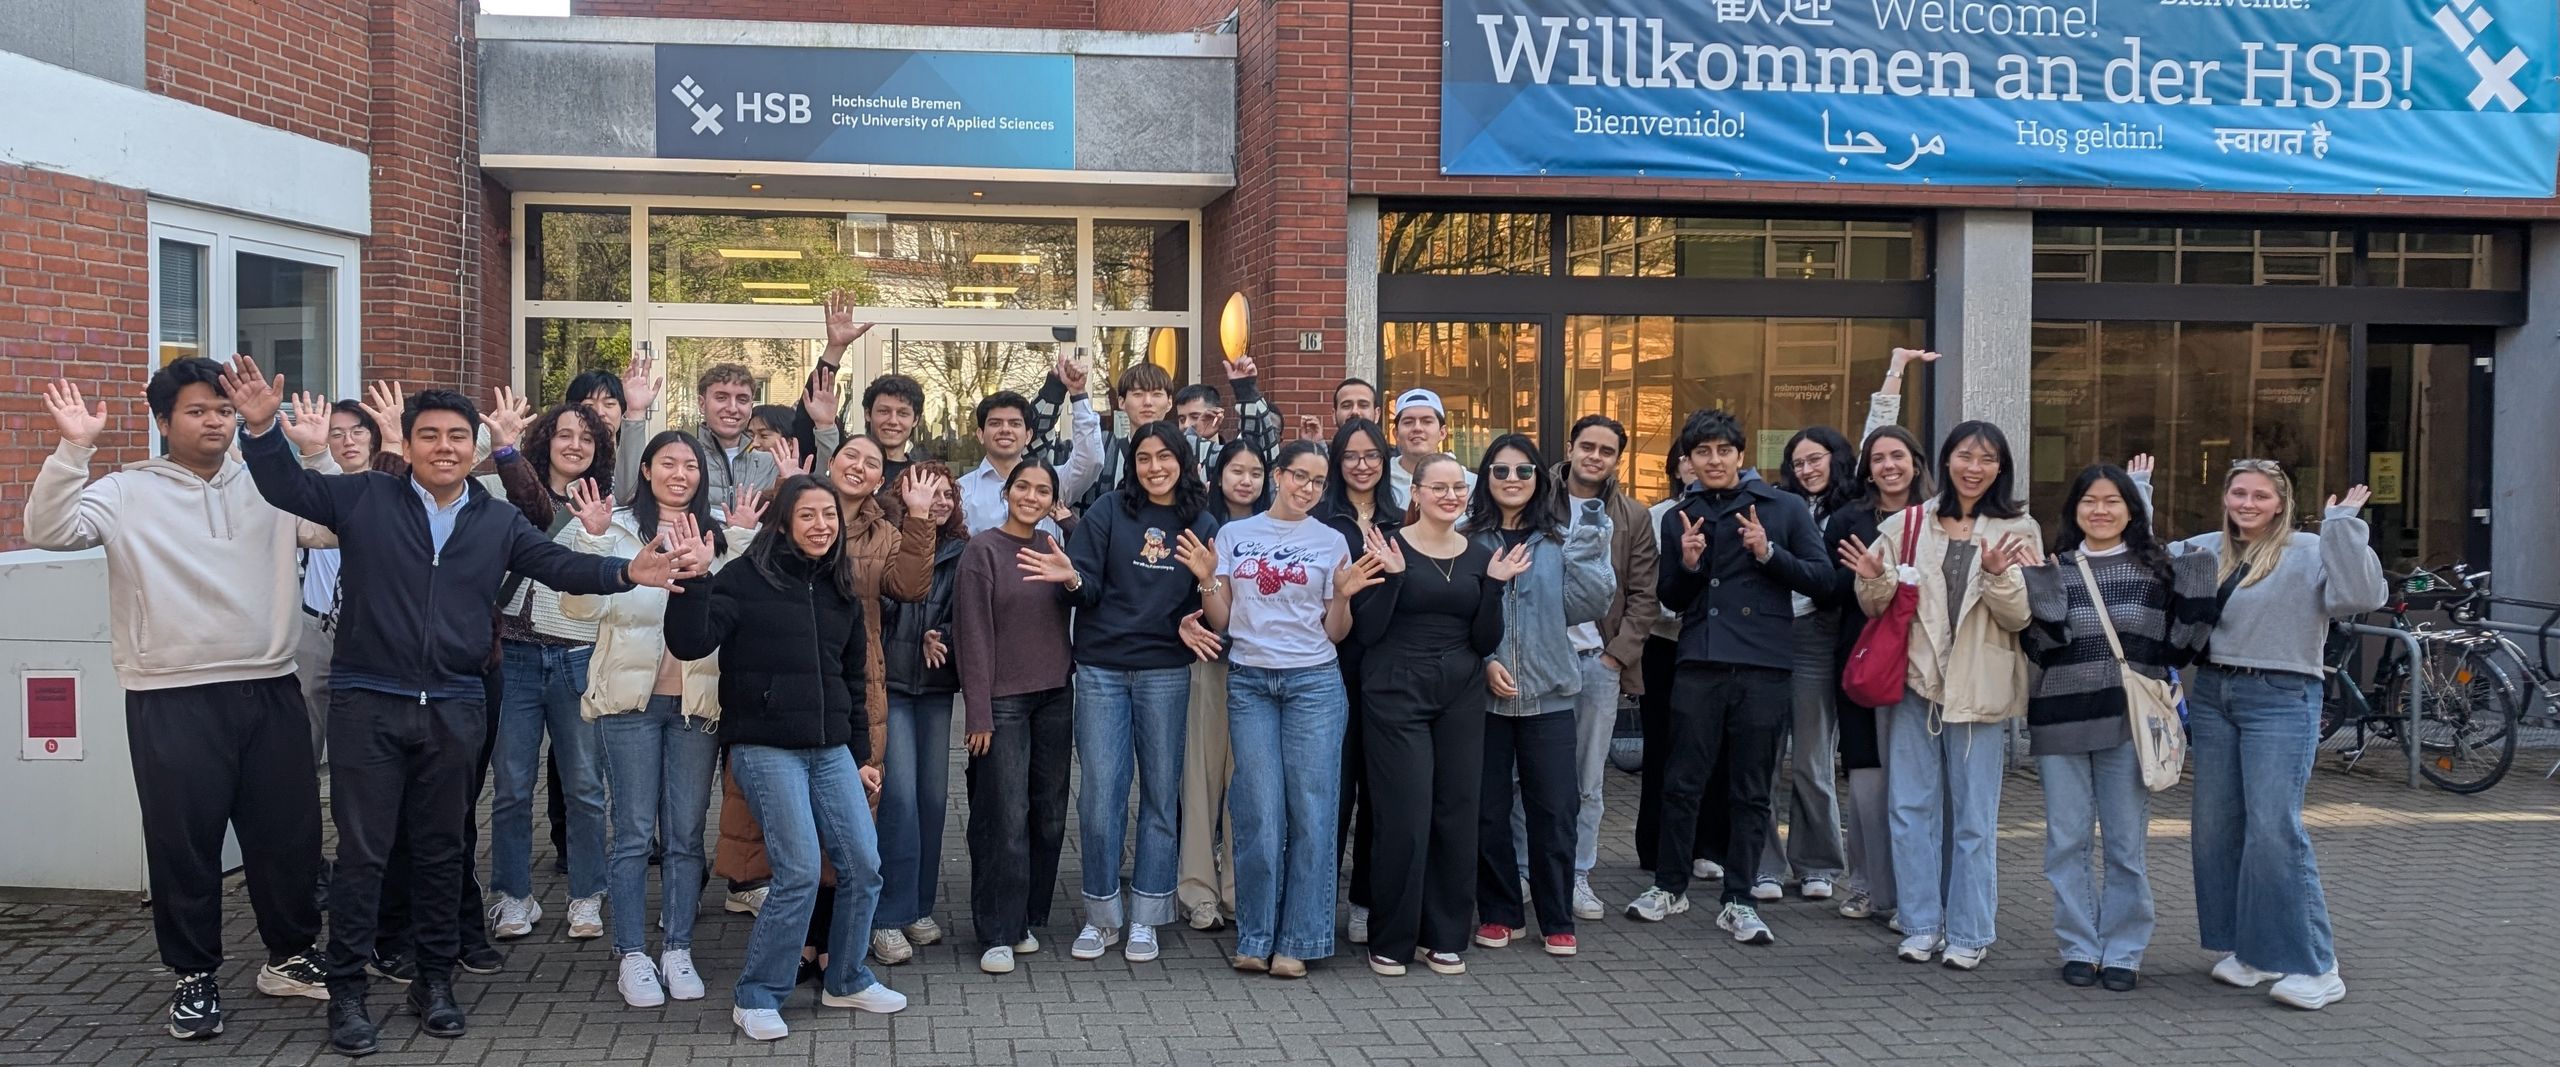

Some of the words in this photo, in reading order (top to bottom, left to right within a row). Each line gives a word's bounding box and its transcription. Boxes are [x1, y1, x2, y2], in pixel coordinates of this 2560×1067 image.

[1873, 0, 2098, 38] Welcome!
[1477, 14, 1976, 98] Willkommen
[1994, 54, 2083, 102] an
[2103, 37, 2221, 106] der
[2240, 42, 2413, 111] HSB!
[736, 92, 812, 124] HSB
[832, 94, 908, 109] Hochschule
[911, 96, 961, 110] Bremen
[832, 112, 858, 129] City
[861, 113, 928, 130] University
[931, 115, 945, 128] of
[947, 115, 996, 131] Applied
[998, 117, 1055, 130] Sciences
[1574, 106, 1745, 138] Bienvenido!
[2015, 120, 2068, 153] Hoş
[2075, 122, 2163, 155] geldin!
[2214, 128, 2306, 156] स्वागत
[2311, 120, 2332, 159] है
[1305, 332, 1318, 350] 16
